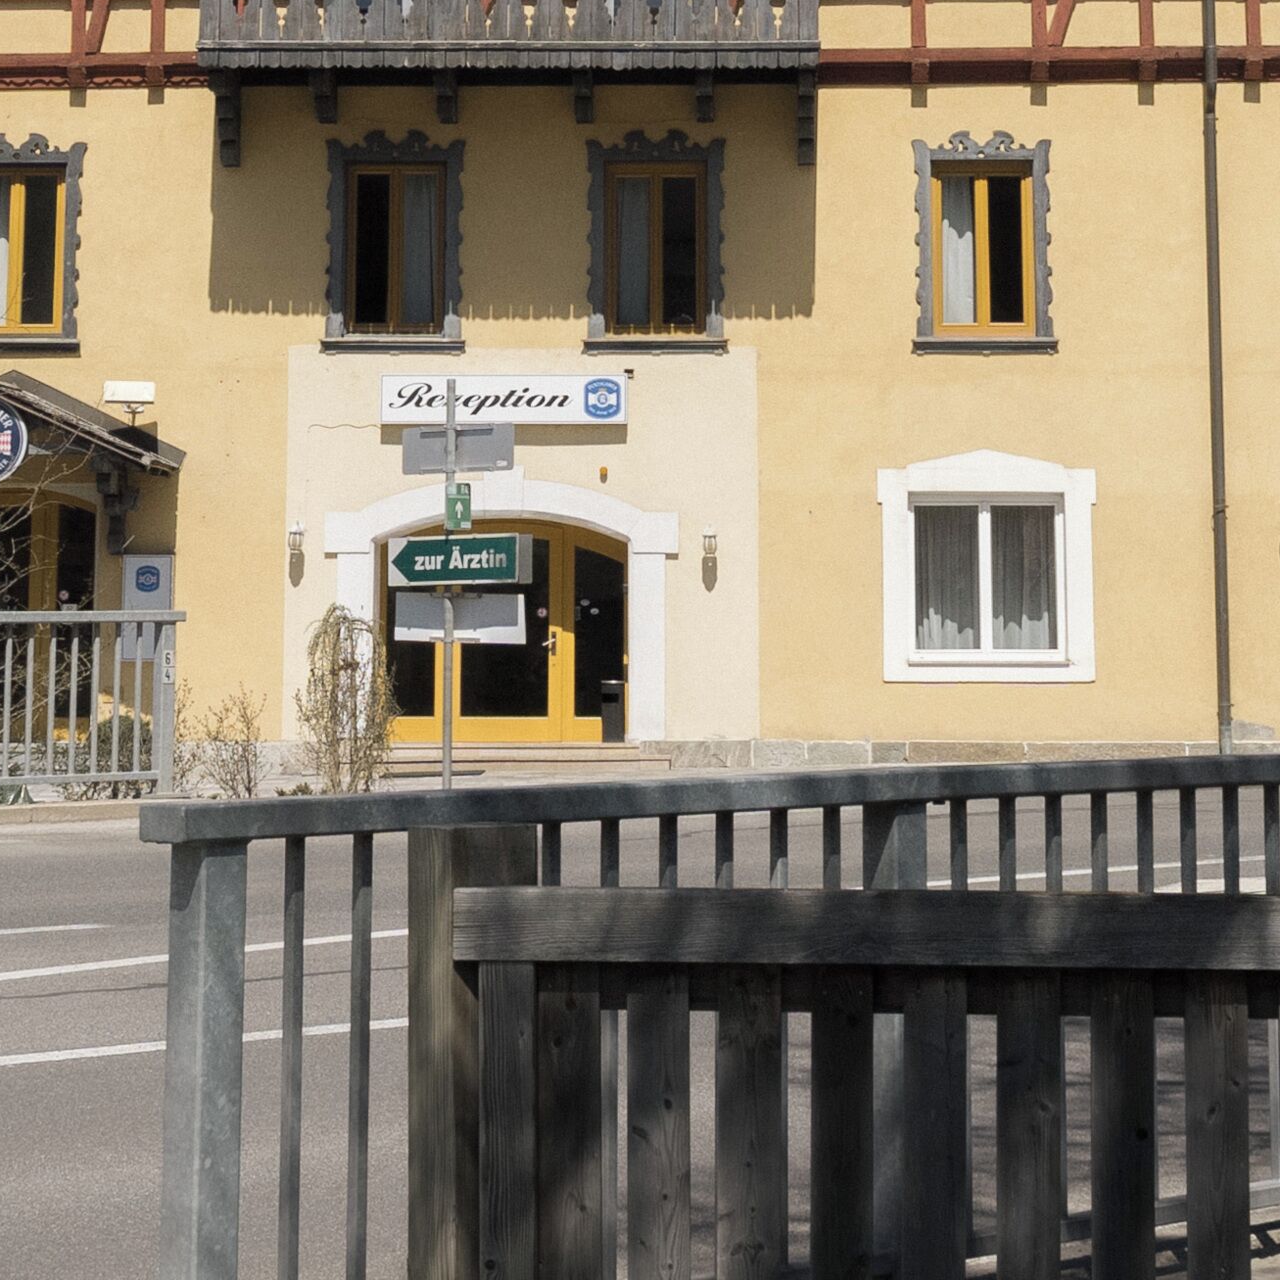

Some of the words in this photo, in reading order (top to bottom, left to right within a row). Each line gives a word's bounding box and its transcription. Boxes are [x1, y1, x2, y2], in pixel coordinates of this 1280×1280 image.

[414, 554, 445, 571] zur
[448, 545, 507, 570] Ärztin
[164, 651, 172, 666] 6
[164, 668, 171, 682] 4
